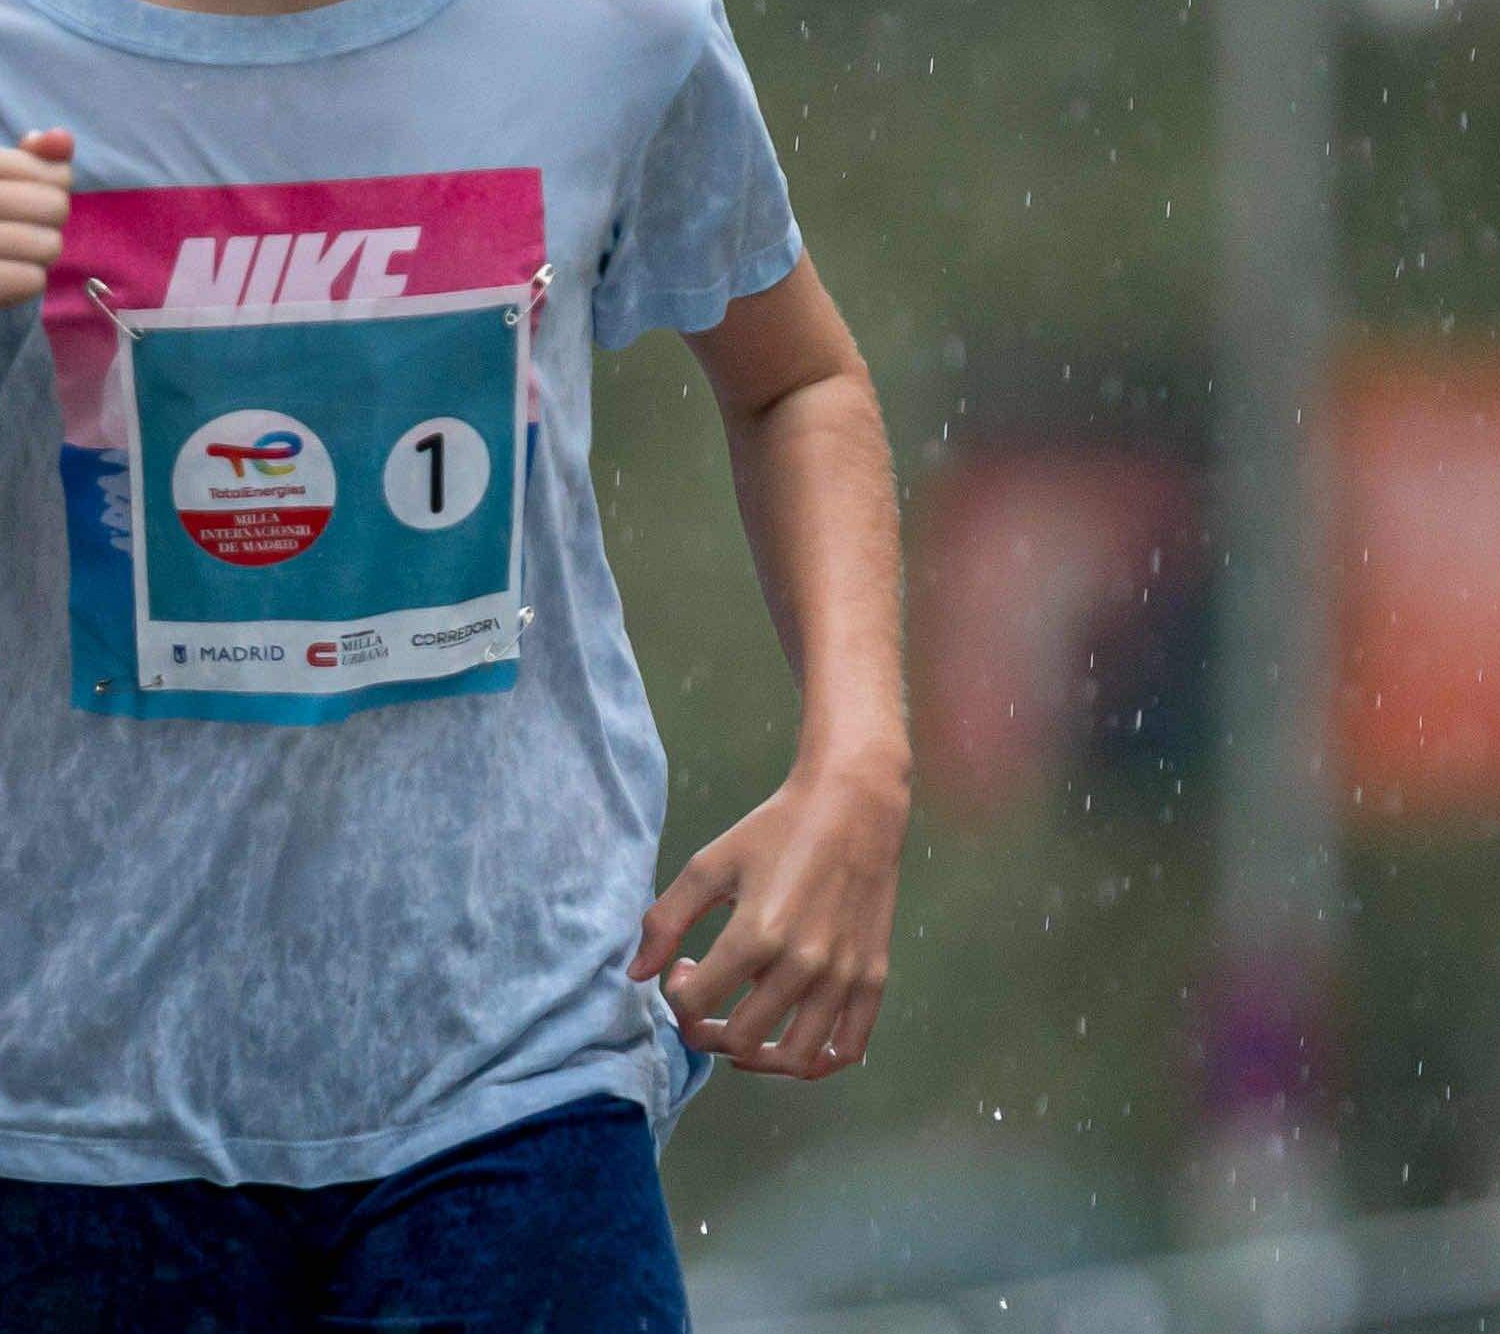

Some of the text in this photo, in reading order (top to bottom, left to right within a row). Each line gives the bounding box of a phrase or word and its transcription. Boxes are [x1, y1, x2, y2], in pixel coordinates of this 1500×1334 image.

[162, 226, 421, 308] NIKE
[416, 432, 444, 514] 1
[208, 484, 306, 499] TotalEnergies
[233, 513, 280, 527] MILLA
[218, 539, 299, 554] DE MADRID
[341, 635, 383, 652] MILLA
[200, 644, 285, 662] MADRID
